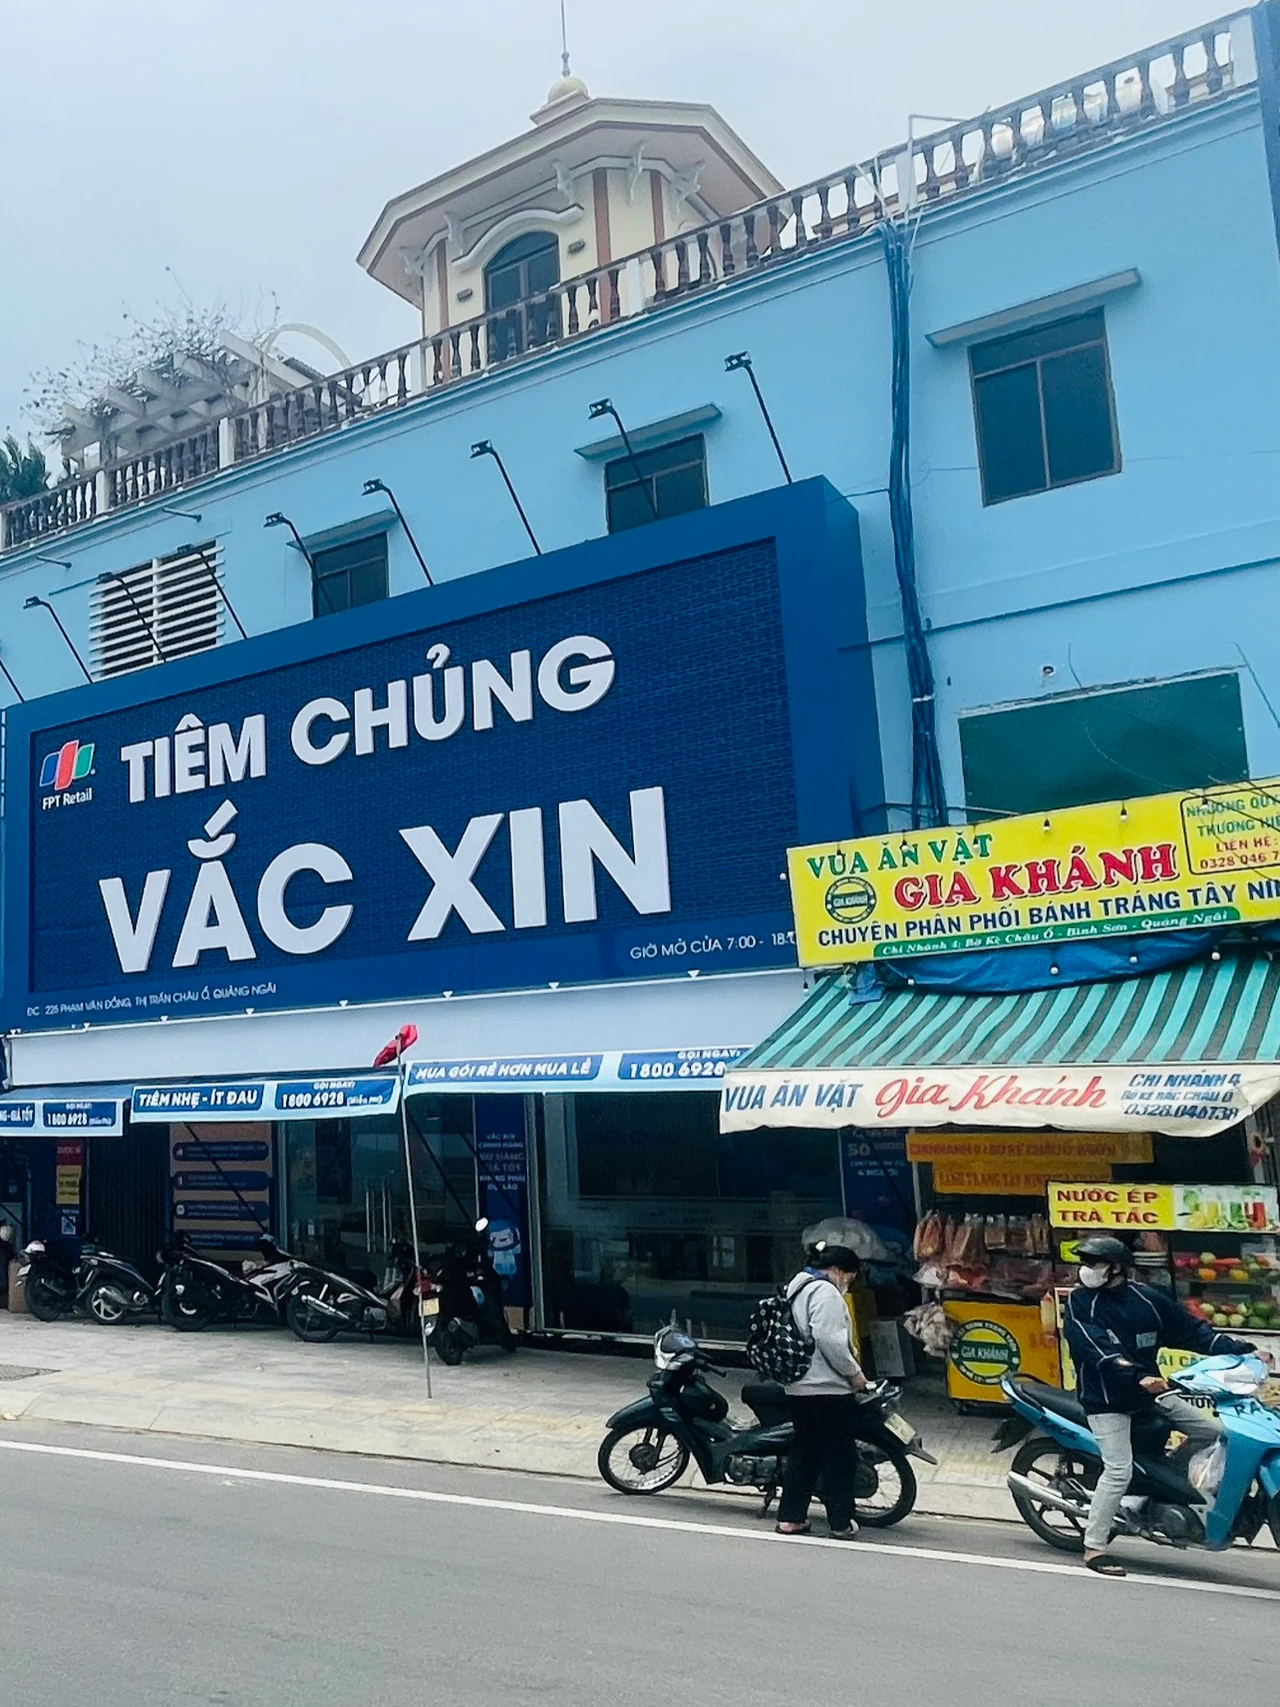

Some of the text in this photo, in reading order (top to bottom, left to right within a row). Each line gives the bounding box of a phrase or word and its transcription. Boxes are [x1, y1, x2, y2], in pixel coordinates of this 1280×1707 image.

[121, 635, 616, 803] TIÊM CHỦNG
[42, 787, 93, 810] FPT Retail
[807, 830, 993, 880] VUA ĂN VẶT
[1200, 856, 1236, 870] 0328
[1240, 852, 1267, 866] 046
[100, 786, 671, 974] VẮC XIN
[895, 844, 1180, 911] GIA KHÁNH
[818, 921, 897, 947] CHUYÊN
[906, 913, 961, 938] PHÂN
[970, 903, 1020, 931] PHỐI
[1028, 895, 1091, 925] BÁNH
[1099, 889, 1181, 917] TRÁNG
[1187, 881, 1236, 906] TÂY
[630, 943, 658, 959] GIỜ
[661, 937, 687, 957] MỞ
[690, 934, 723, 953] CỬA
[727, 935, 756, 950] 7:00
[882, 946, 904, 956] Chi
[906, 940, 947, 954] Nhánh
[1005, 929, 1039, 943] Châu
[1067, 924, 1098, 936] Bình
[1102, 921, 1128, 933] Sơn
[677, 1050, 701, 1061] GỌI
[416, 1058, 590, 1080] MUA GÓI RẺ HƠN MUA LẺ
[630, 1062, 675, 1078] 1800
[1128, 1069, 1242, 1087] CHI NHÁNH 4
[139, 1087, 258, 1110] TIÊM NHẸ ÍT ĐAU
[282, 1091, 344, 1109] 1800 6928
[724, 1083, 767, 1113] VUA
[770, 1080, 808, 1108] ĂN
[815, 1079, 864, 1113] VẶT
[949, 1075, 1107, 1111] Khánh
[47, 1112, 87, 1126] 1800 6928
[1057, 1188, 1158, 1204] NƯỚC ÉP
[1057, 1208, 1104, 1223] TRÀ
